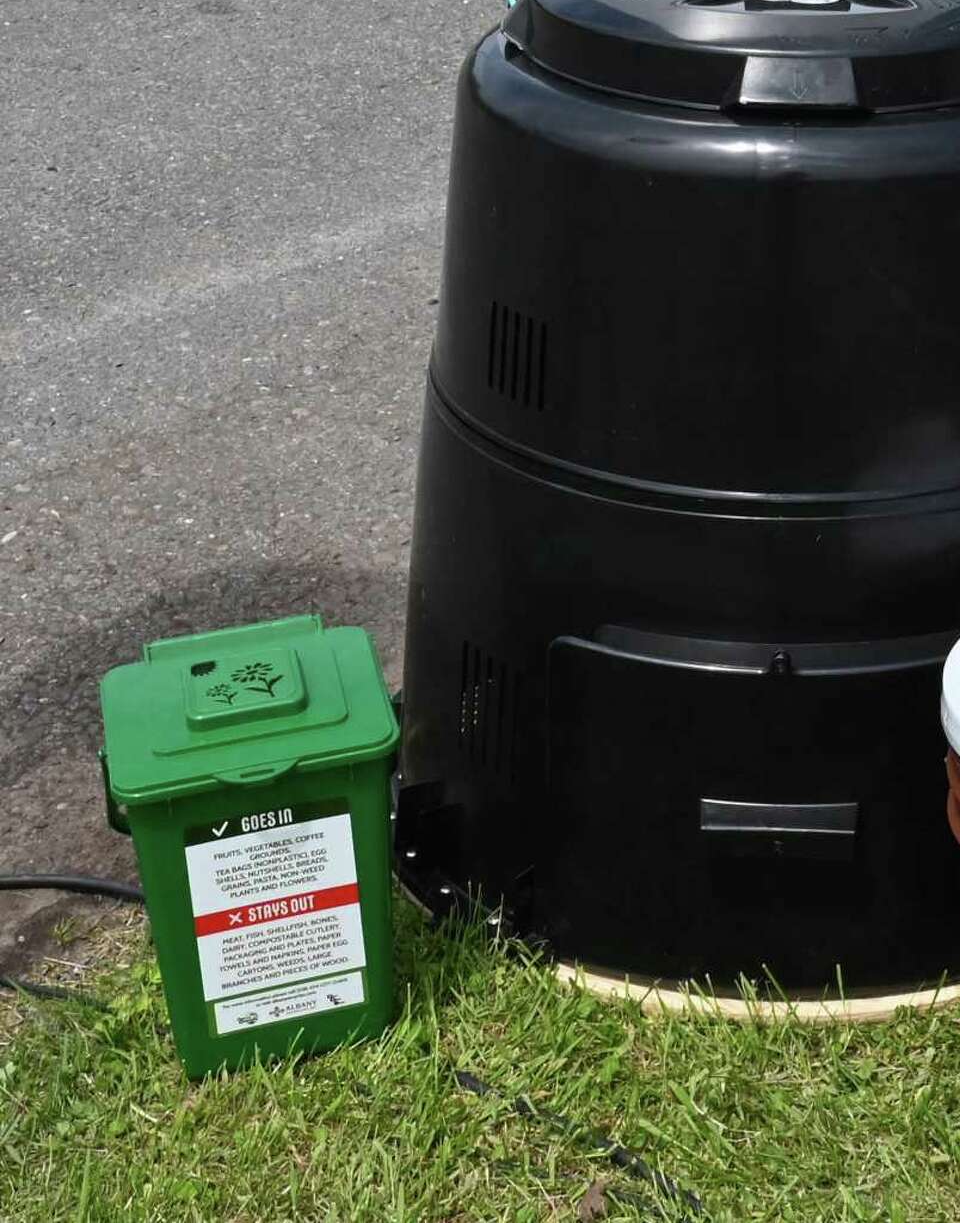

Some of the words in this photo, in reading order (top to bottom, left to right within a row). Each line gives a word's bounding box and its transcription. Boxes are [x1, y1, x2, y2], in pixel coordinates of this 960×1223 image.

[241, 811, 276, 832] GOES
[296, 832, 324, 843] COFFEE
[215, 869, 230, 877] TEA
[232, 864, 252, 874] BAGS
[311, 848, 327, 857] EGG
[230, 888, 259, 898] PLANTS
[261, 883, 278, 892] AND
[248, 900, 288, 922] STAYS
[291, 895, 315, 913] OUT
[224, 949, 267, 963] PACKAGING
[269, 944, 286, 953] AND
[318, 932, 341, 943] PAPER
[248, 930, 304, 949] COMPOSTABLE
[220, 961, 251, 972] TOWELS
[253, 956, 269, 966] AND
[307, 943, 331, 953] PAPER
[333, 940, 349, 948] EGG
[307, 952, 332, 961] LARGE
[222, 975, 262, 990] BRANCHES
[264, 970, 281, 979] AND
[282, 964, 308, 976] PIECES
[310, 962, 320, 970] OF
